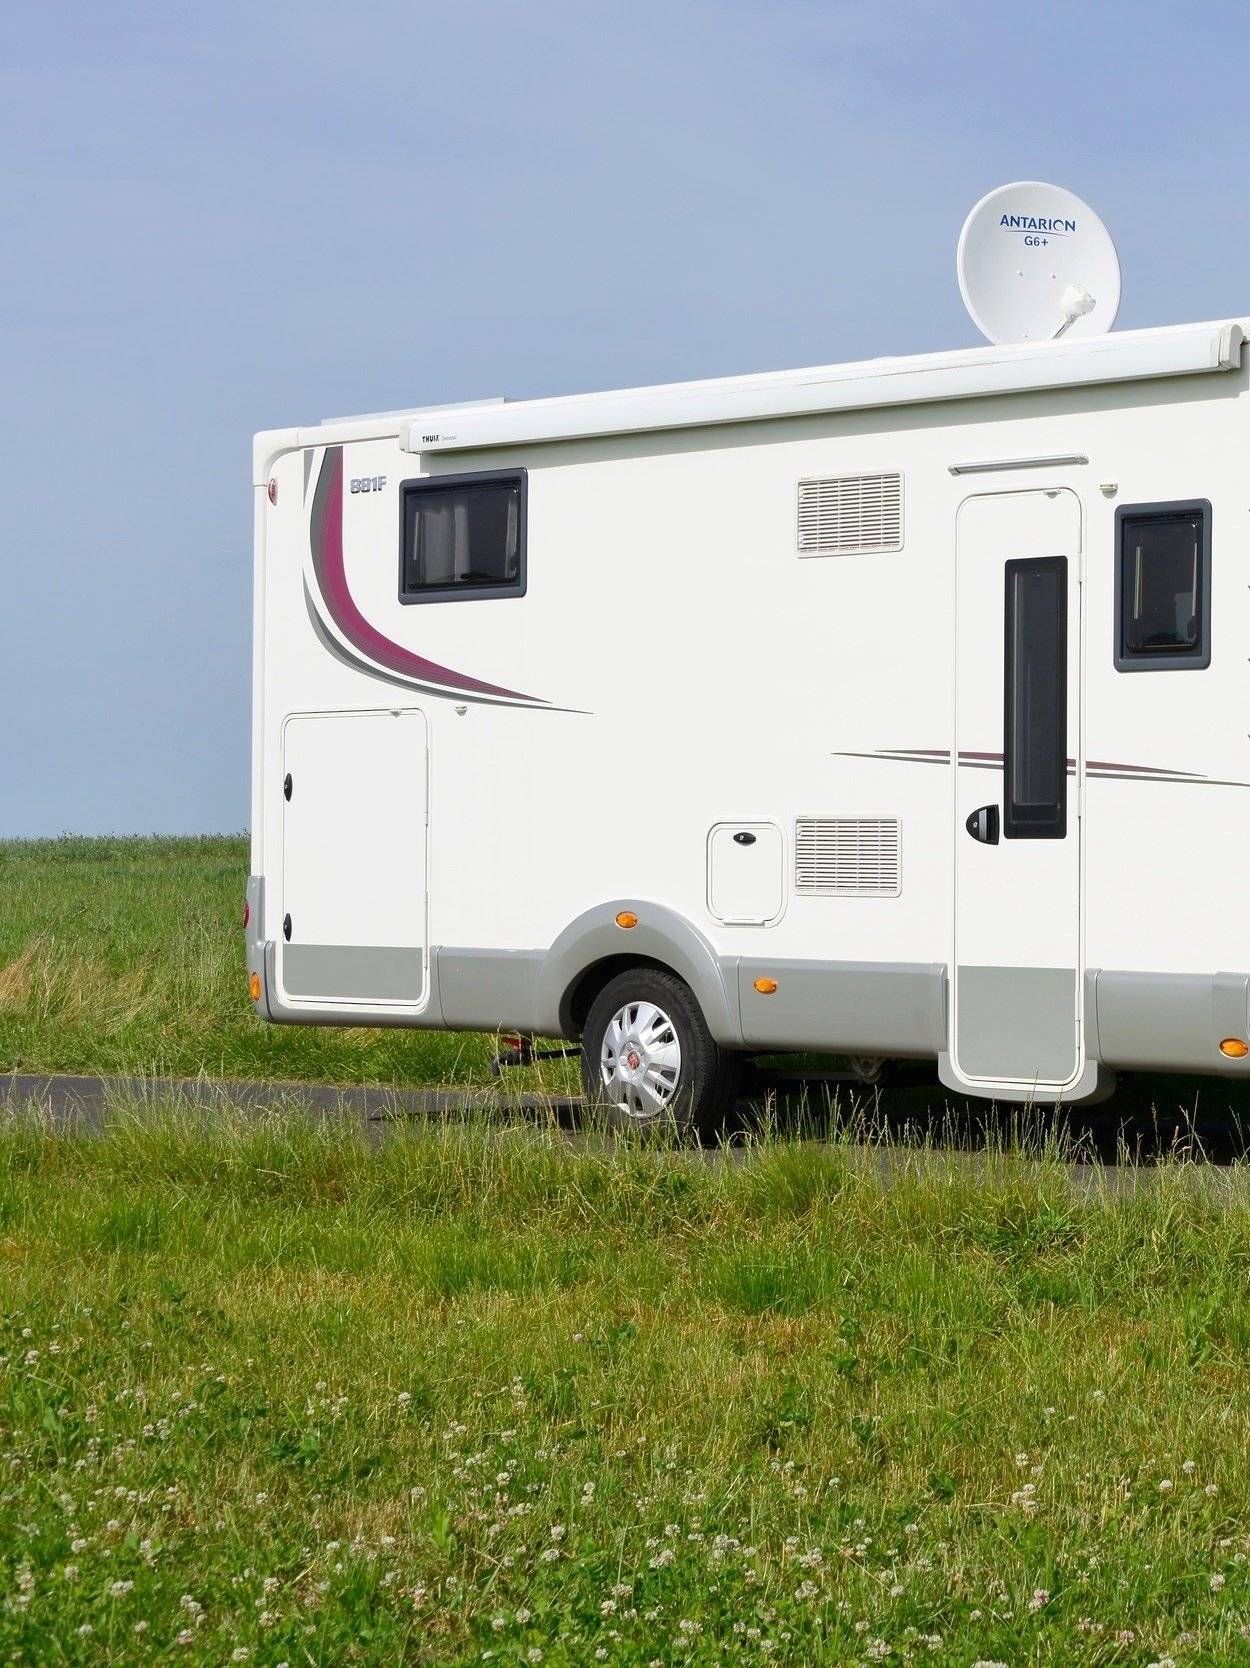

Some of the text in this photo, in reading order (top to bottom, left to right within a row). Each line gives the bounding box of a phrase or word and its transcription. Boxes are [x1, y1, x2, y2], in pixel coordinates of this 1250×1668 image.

[1000, 214, 1076, 232] ANTARION
[1024, 236, 1049, 247] G6+
[422, 434, 440, 443] THULE
[350, 475, 387, 494] 881F
